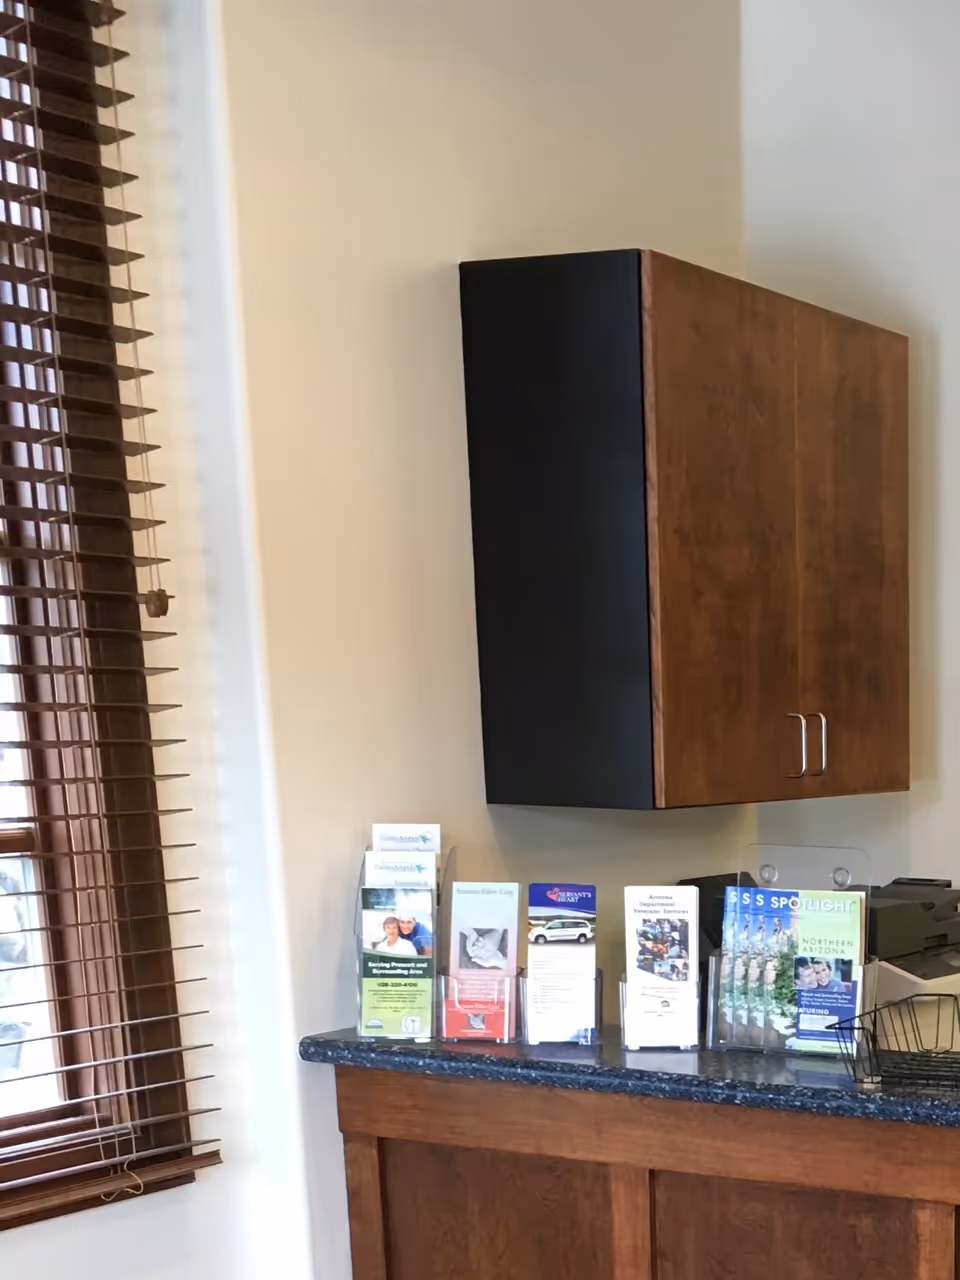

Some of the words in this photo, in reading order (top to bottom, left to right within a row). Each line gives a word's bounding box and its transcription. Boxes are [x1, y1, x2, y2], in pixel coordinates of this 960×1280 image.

[771, 896, 853, 913] SPOTLIGHT
[802, 938, 854, 947] NORTHERN
[802, 946, 846, 955] ARIZONA
